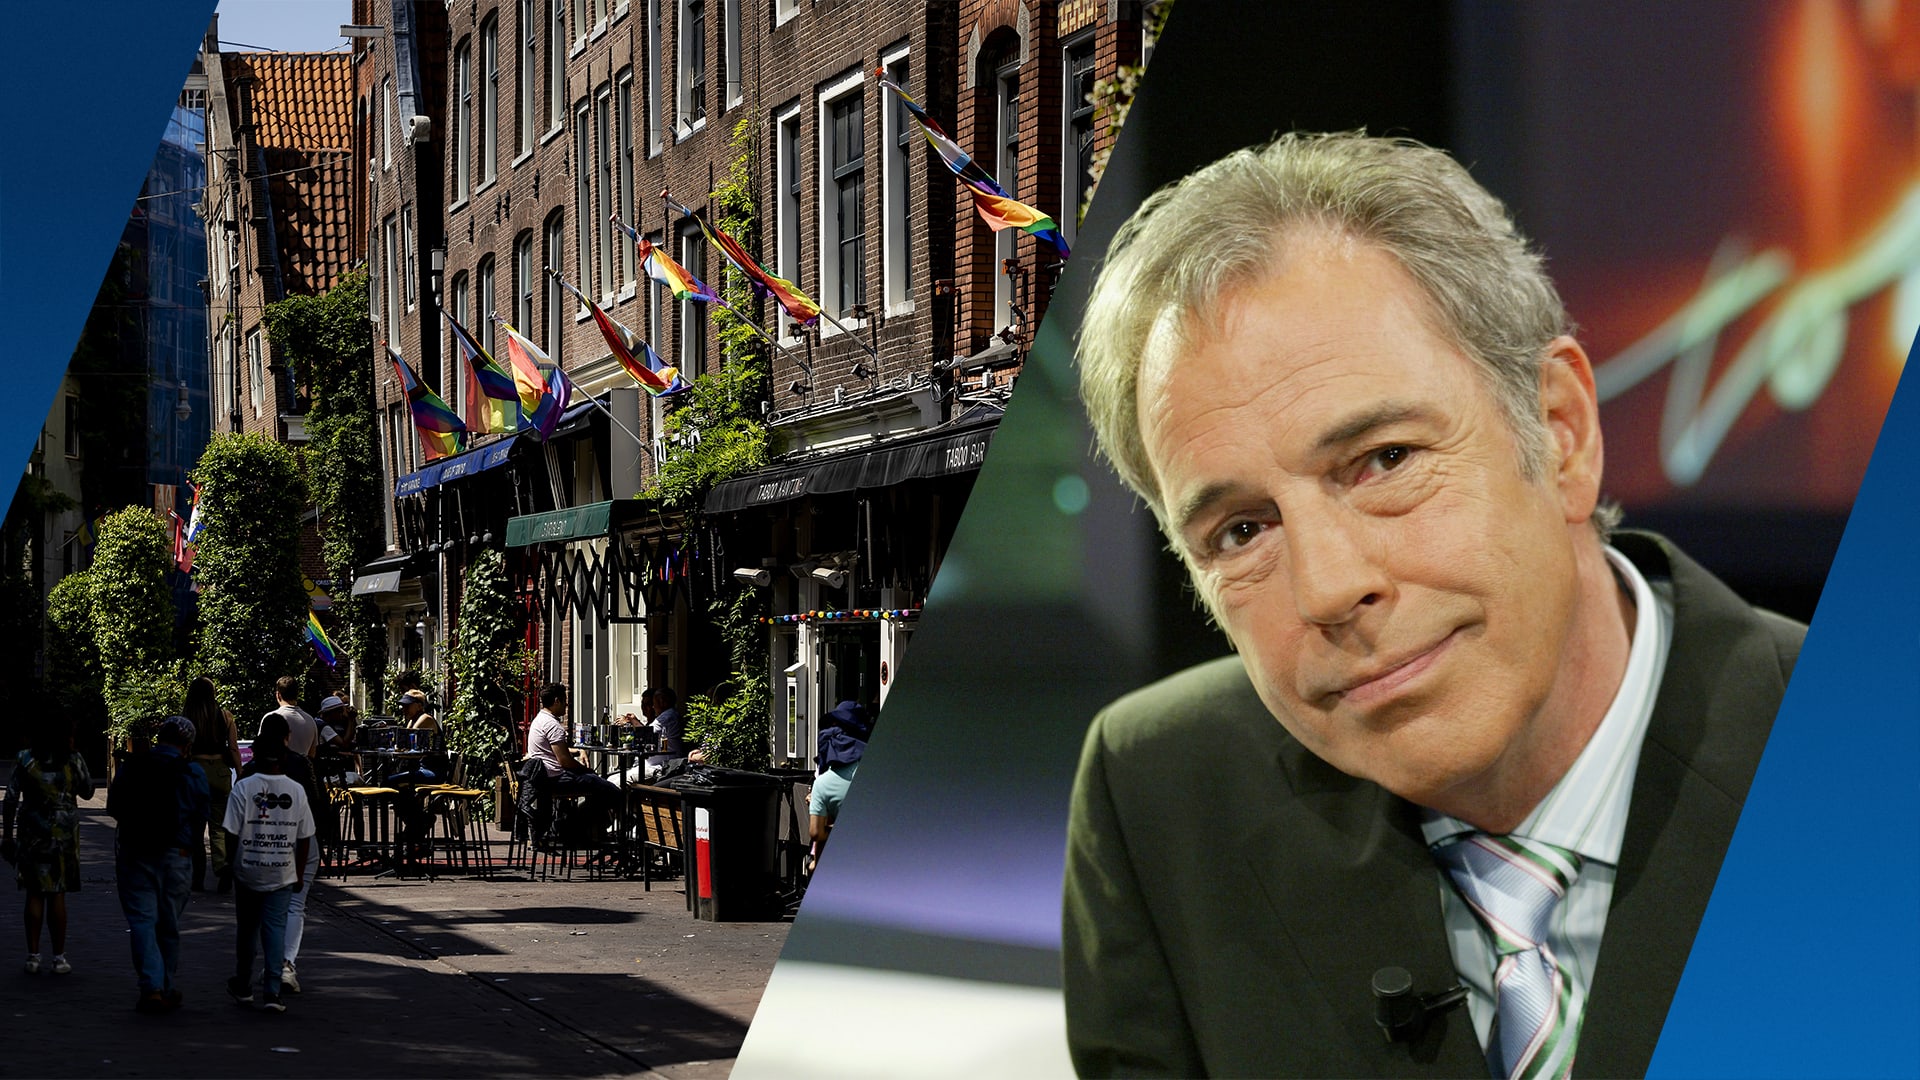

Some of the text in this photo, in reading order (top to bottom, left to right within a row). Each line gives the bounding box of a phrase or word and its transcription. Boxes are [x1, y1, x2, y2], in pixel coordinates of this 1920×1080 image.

[945, 441, 986, 469] TABOO BAR
[756, 482, 778, 501] TABOO
[266, 833, 288, 841] YEARS
[253, 840, 295, 848] STORYTELLIN
